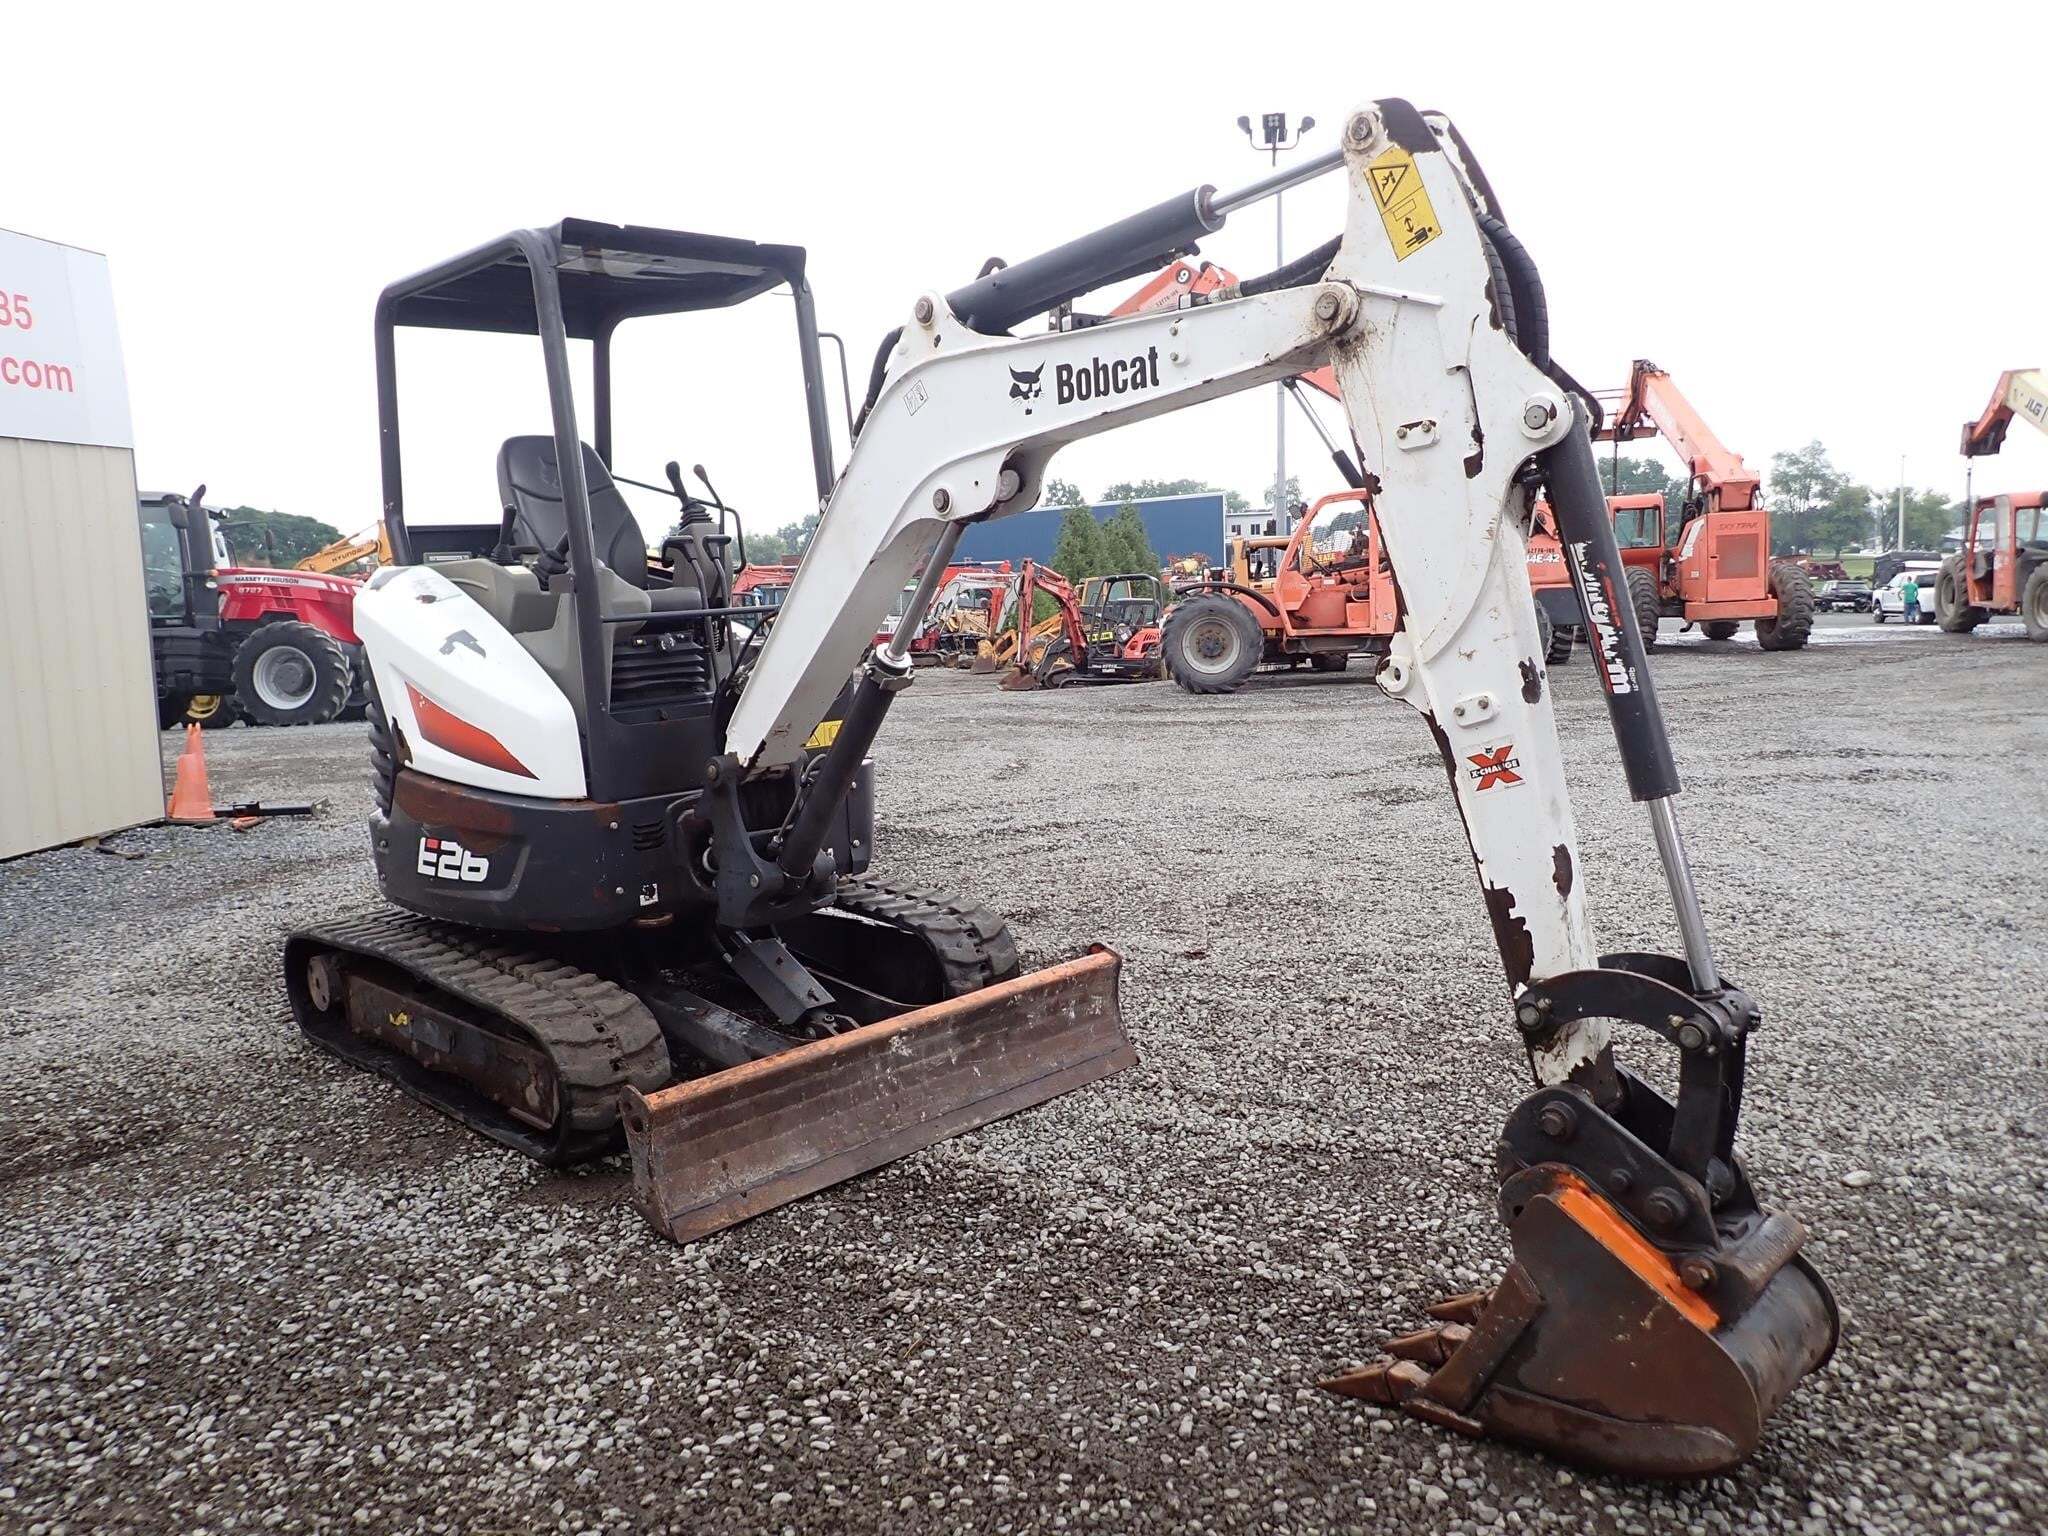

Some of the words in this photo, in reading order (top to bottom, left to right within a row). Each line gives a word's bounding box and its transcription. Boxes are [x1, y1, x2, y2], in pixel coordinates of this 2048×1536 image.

[1056, 346, 1160, 405] Bobcat
[2025, 397, 2043, 416] JLG
[263, 576, 299, 584] FERGUSON
[1471, 759, 1518, 778] X-CHANGE
[417, 836, 489, 882] E26
